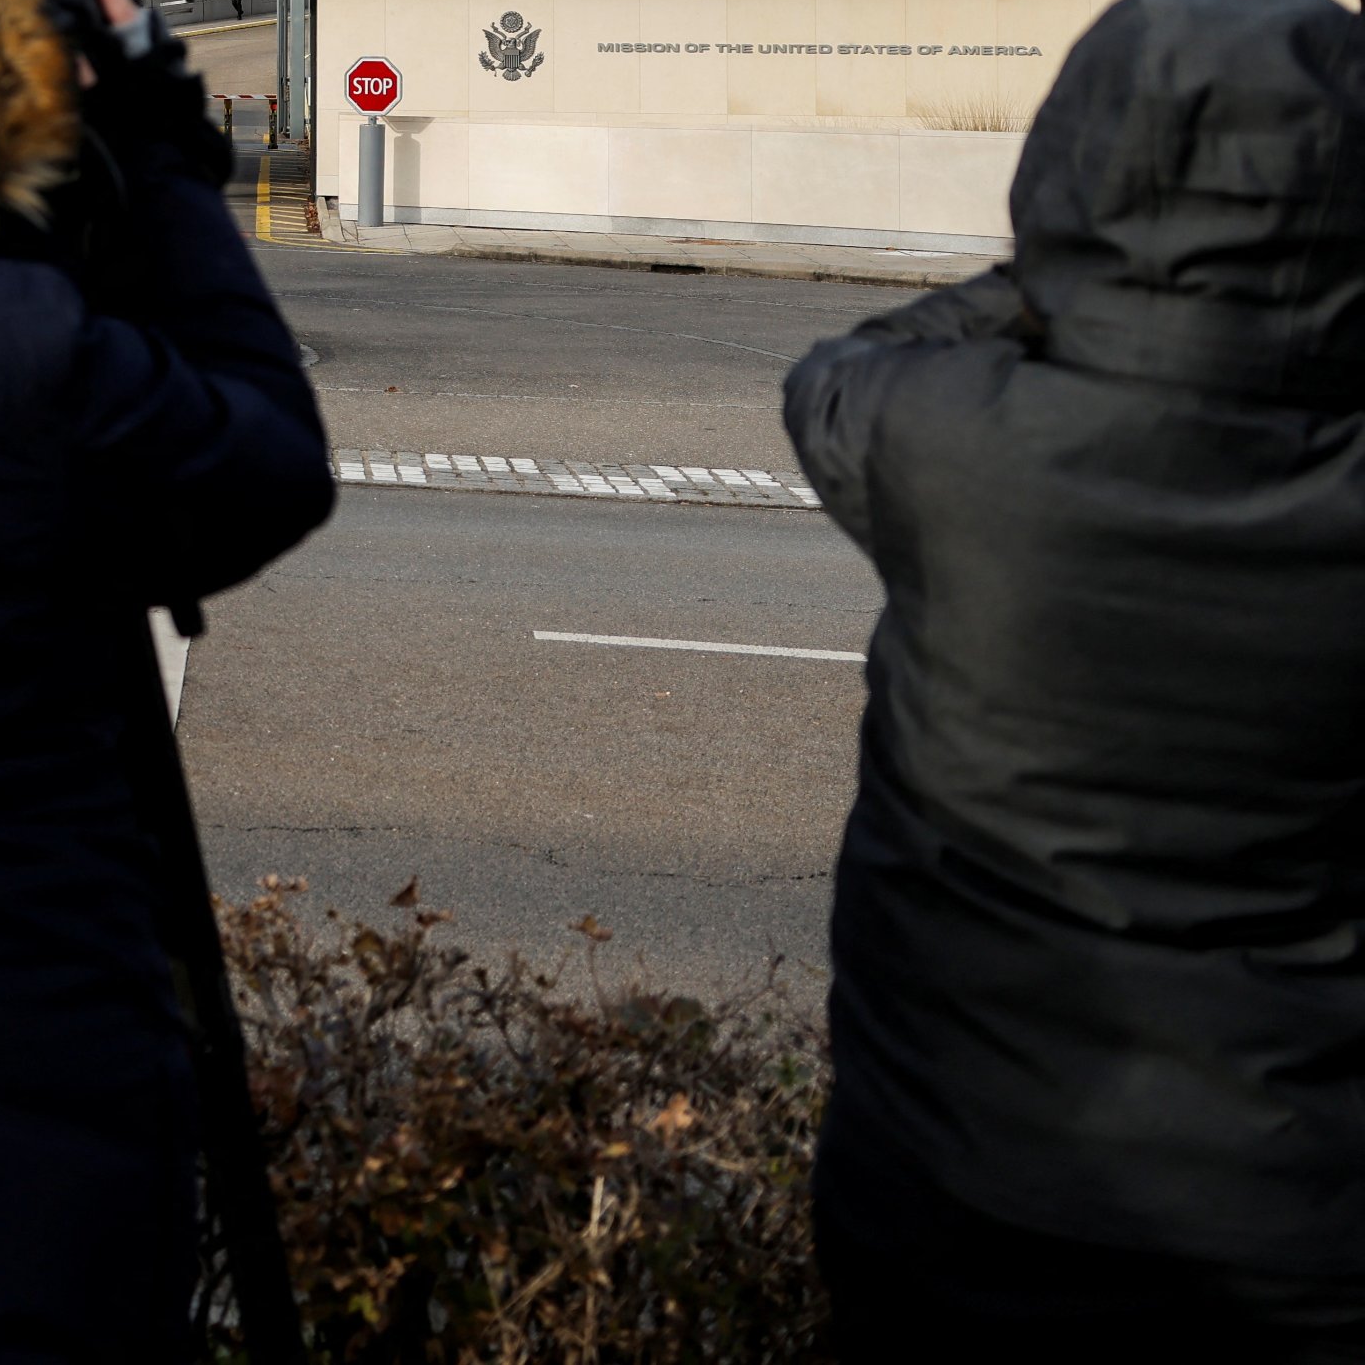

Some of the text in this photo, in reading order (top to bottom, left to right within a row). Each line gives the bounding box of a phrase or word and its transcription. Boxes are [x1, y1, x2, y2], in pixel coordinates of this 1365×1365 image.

[597, 42, 1042, 56] MISSION OF THE UNITED STATES OF AMERICA
[352, 77, 393, 95] STOP
